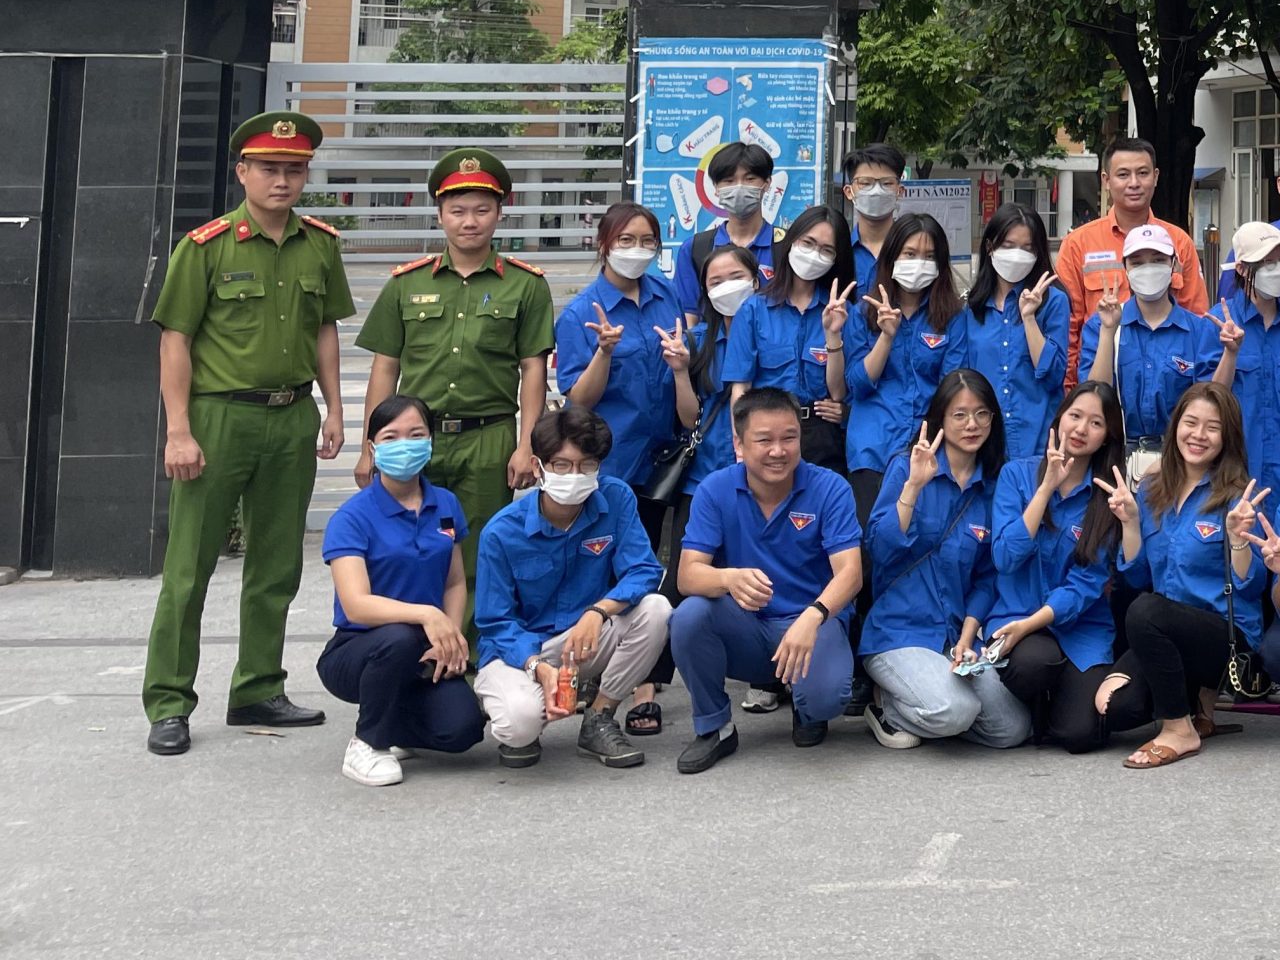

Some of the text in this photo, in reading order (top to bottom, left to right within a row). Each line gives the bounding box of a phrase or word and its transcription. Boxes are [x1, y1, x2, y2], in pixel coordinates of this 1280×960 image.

[675, 45, 697, 55] SỐNG
[699, 47, 710, 55] AN
[712, 45, 734, 55] TOÀN
[735, 45, 749, 55] VỚI
[751, 47, 764, 57] ĐẠI
[766, 47, 785, 57] DỊCH
[787, 47, 823, 56] COVID-19
